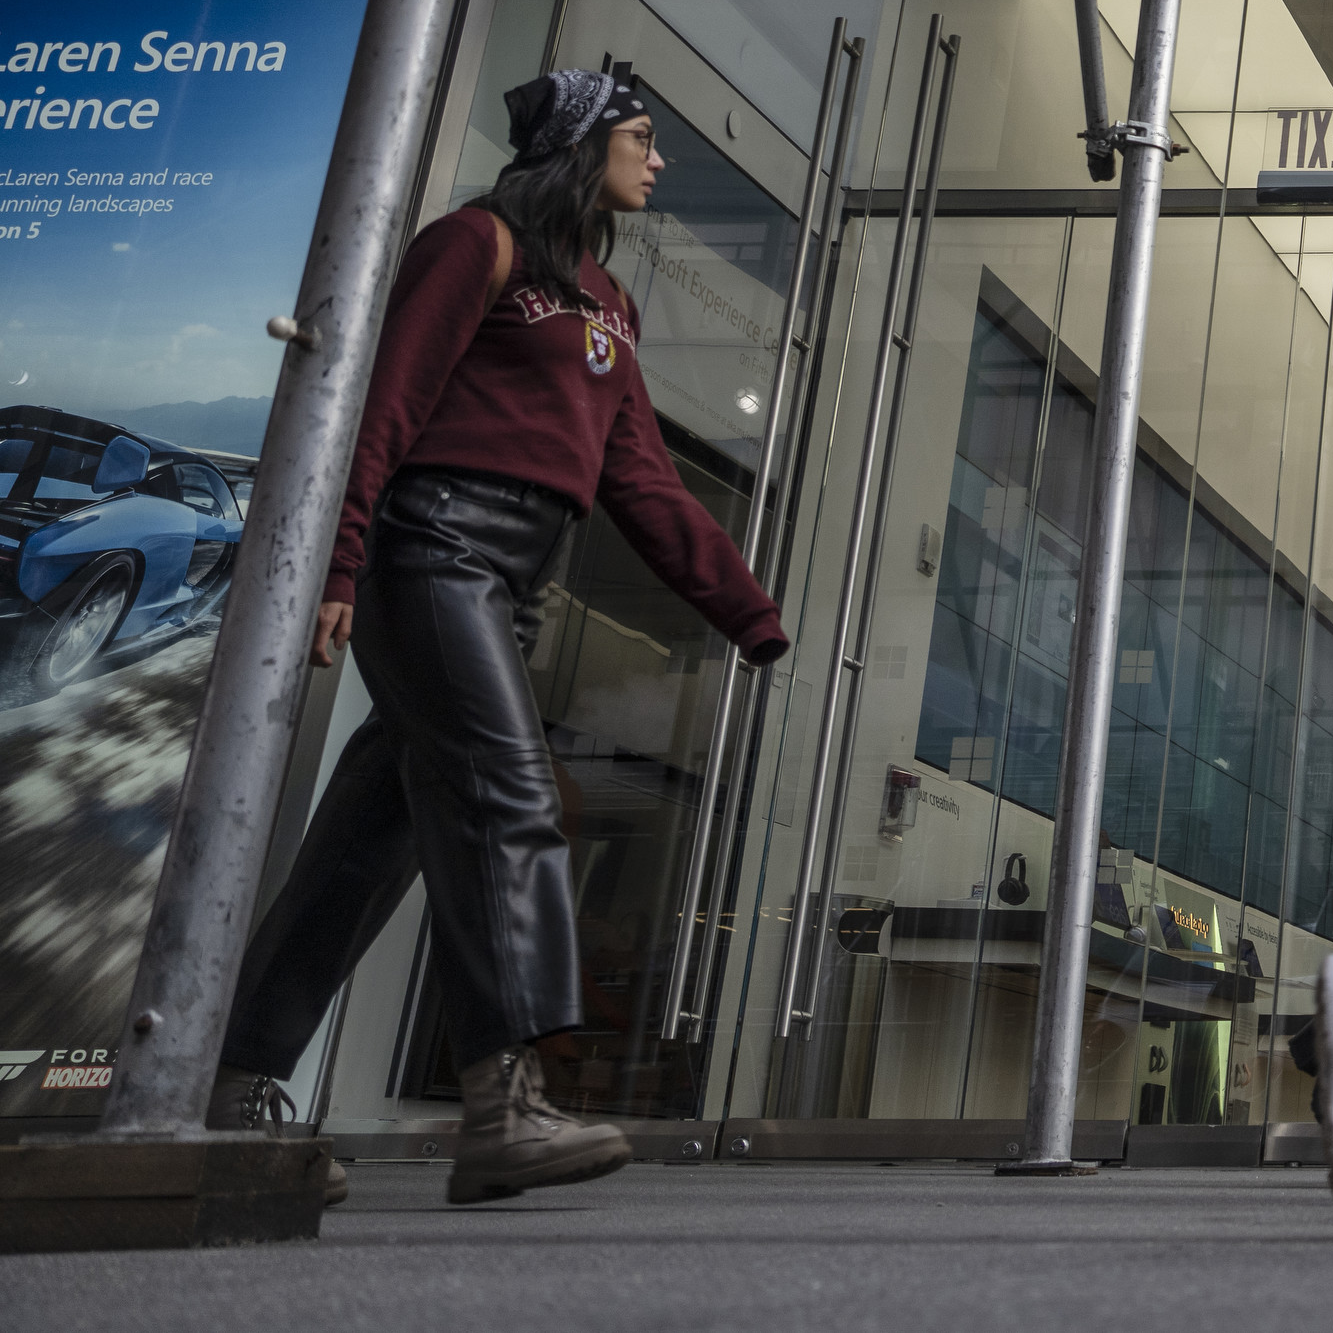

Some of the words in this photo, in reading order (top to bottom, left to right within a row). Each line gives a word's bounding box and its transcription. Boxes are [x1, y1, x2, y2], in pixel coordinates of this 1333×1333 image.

[134, 30, 287, 73] Senna
[64, 168, 124, 187] Senna
[129, 167, 169, 187] and
[172, 171, 213, 187] race
[68, 194, 174, 217] landscapes
[27, 221, 41, 240] 5
[617, 215, 688, 289] Microsoft
[689, 270, 761, 342] Experience
[929, 792, 960, 821] creativity
[43, 1066, 113, 1088] HORIZO
